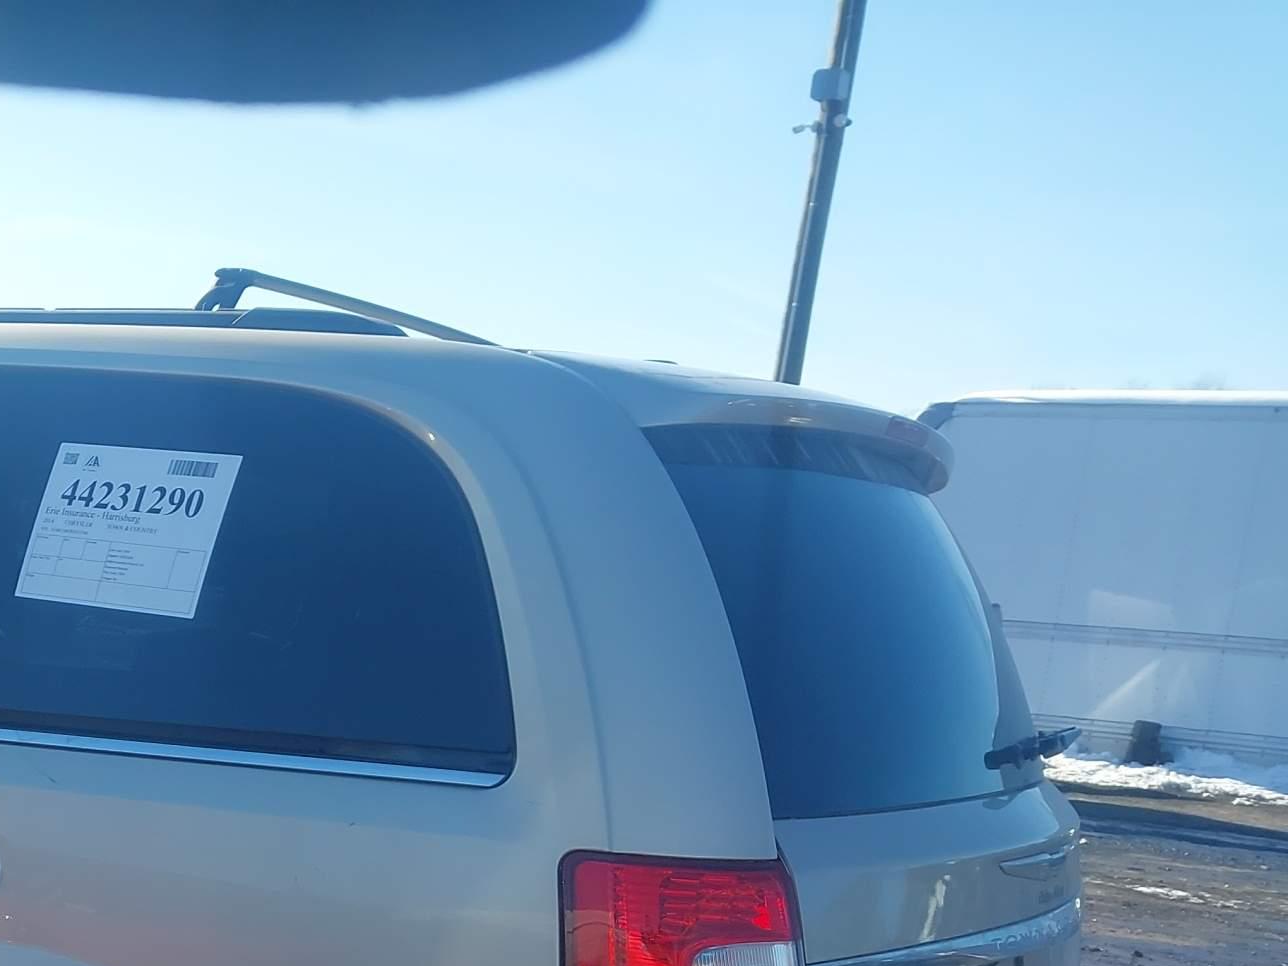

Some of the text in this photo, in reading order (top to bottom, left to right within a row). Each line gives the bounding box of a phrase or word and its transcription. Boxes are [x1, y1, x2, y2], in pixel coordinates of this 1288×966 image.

[60, 478, 205, 518] 44231290
[45, 506, 60, 516] Erie
[61, 508, 95, 519] Insurance
[102, 511, 141, 525] Harrisburg
